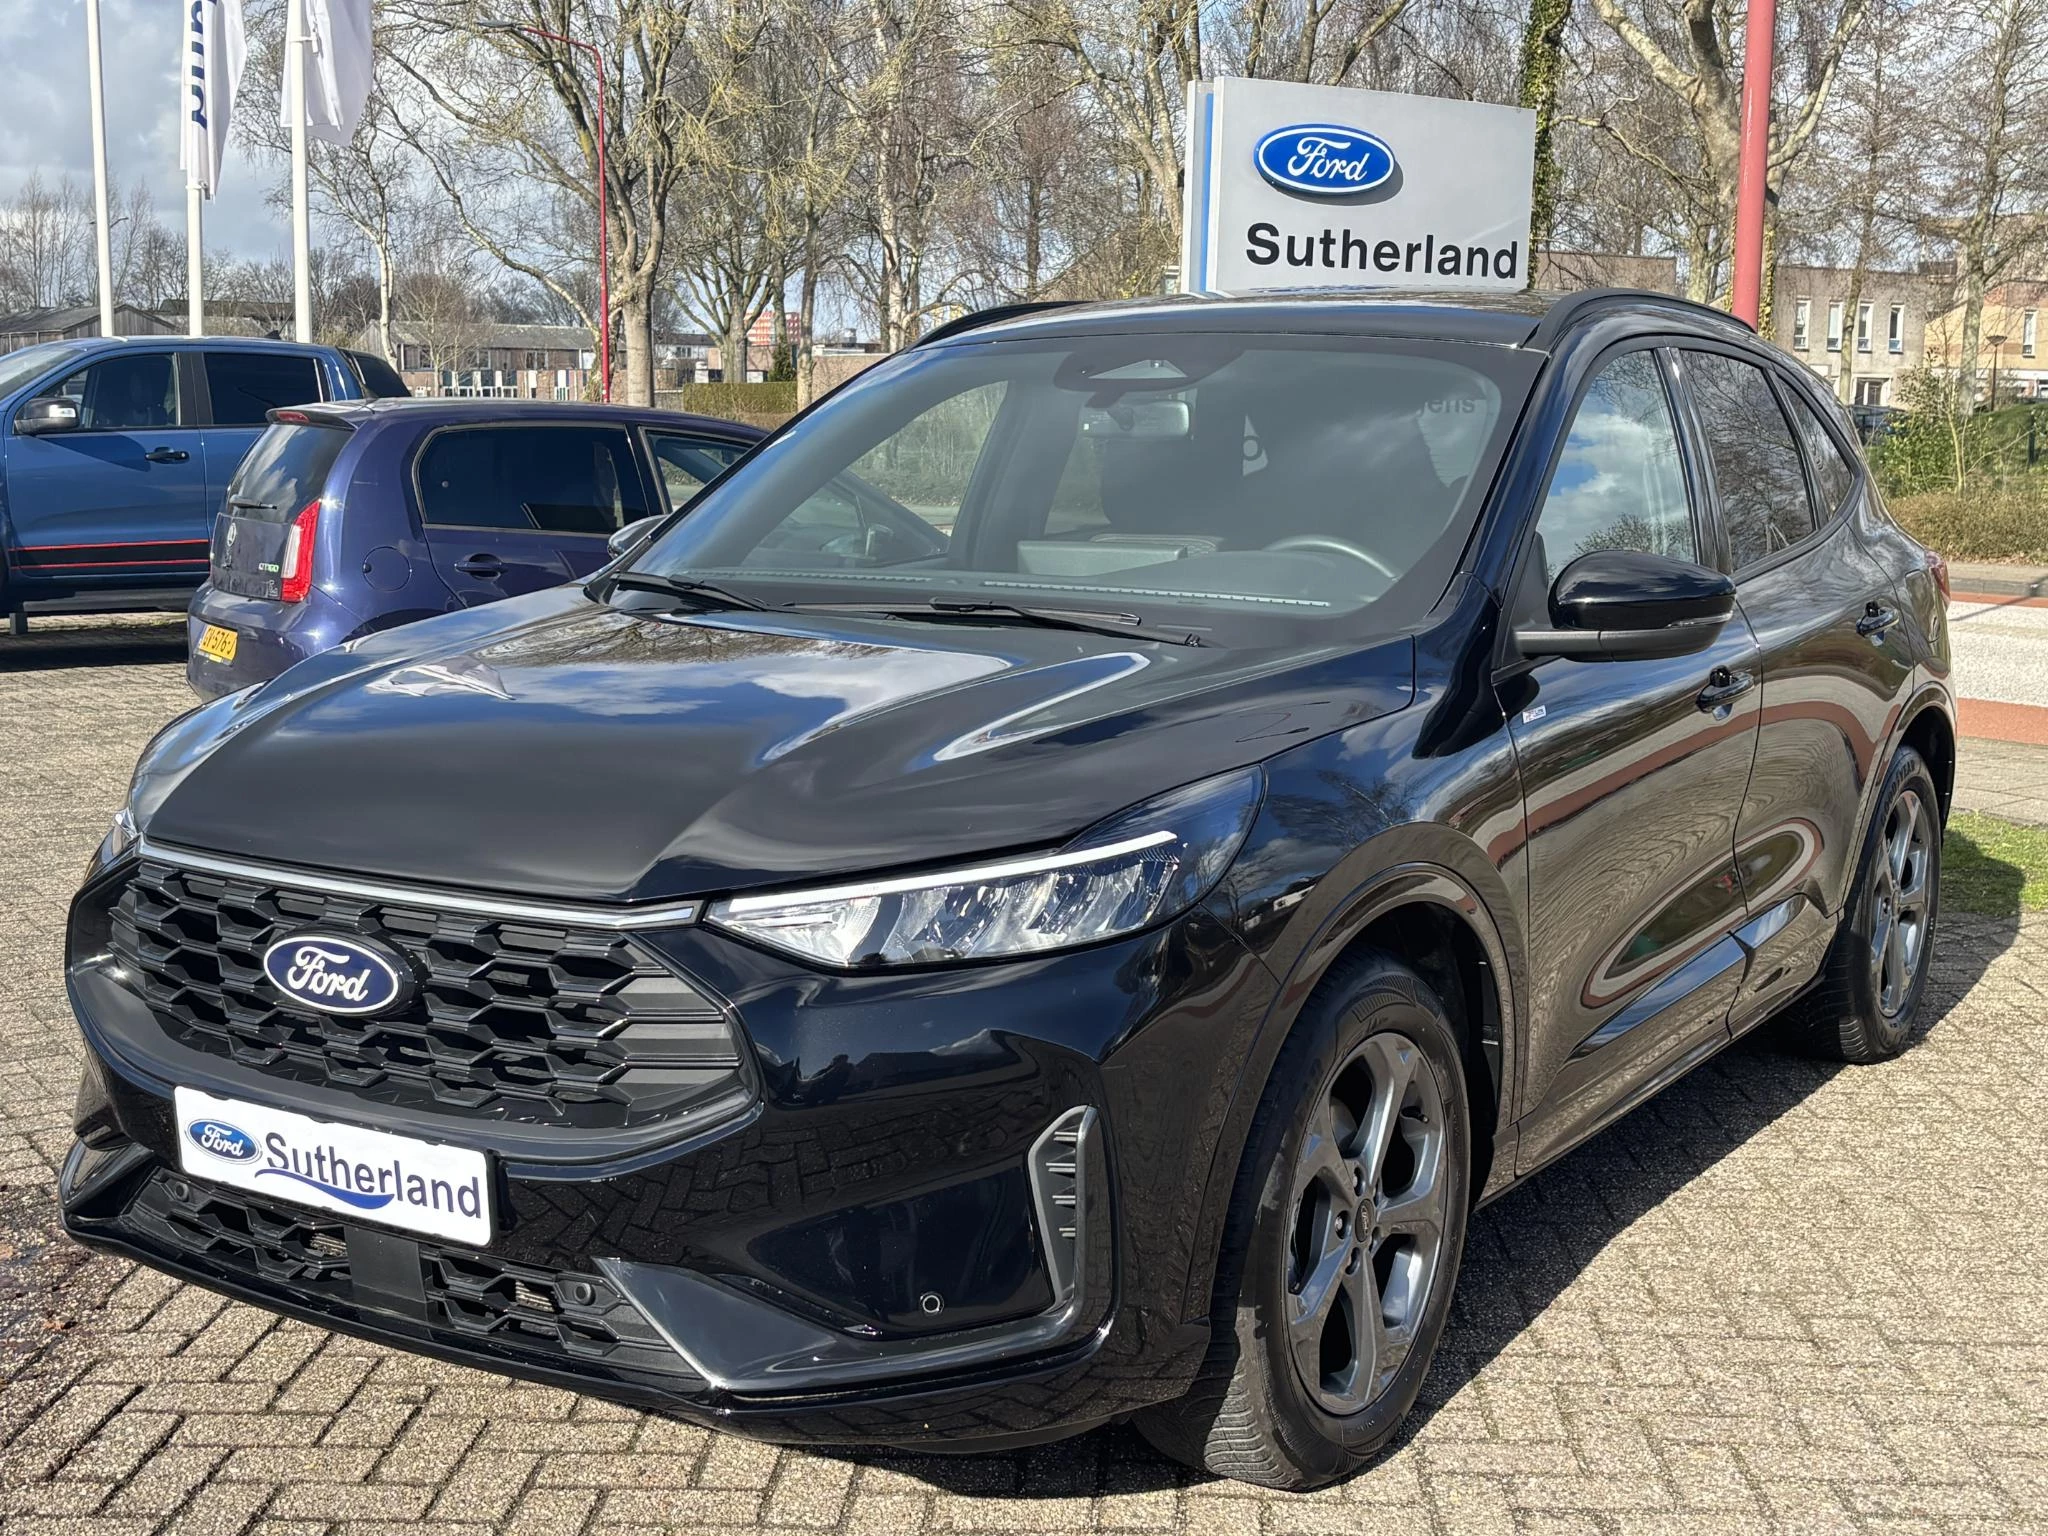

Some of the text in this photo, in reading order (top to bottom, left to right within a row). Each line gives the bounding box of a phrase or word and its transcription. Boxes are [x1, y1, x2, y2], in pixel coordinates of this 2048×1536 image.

[1287, 136, 1369, 181] Ford
[1246, 221, 1518, 279] Sutherland
[286, 945, 372, 1002] Ford
[200, 1123, 482, 1219] Ford Sutherland
